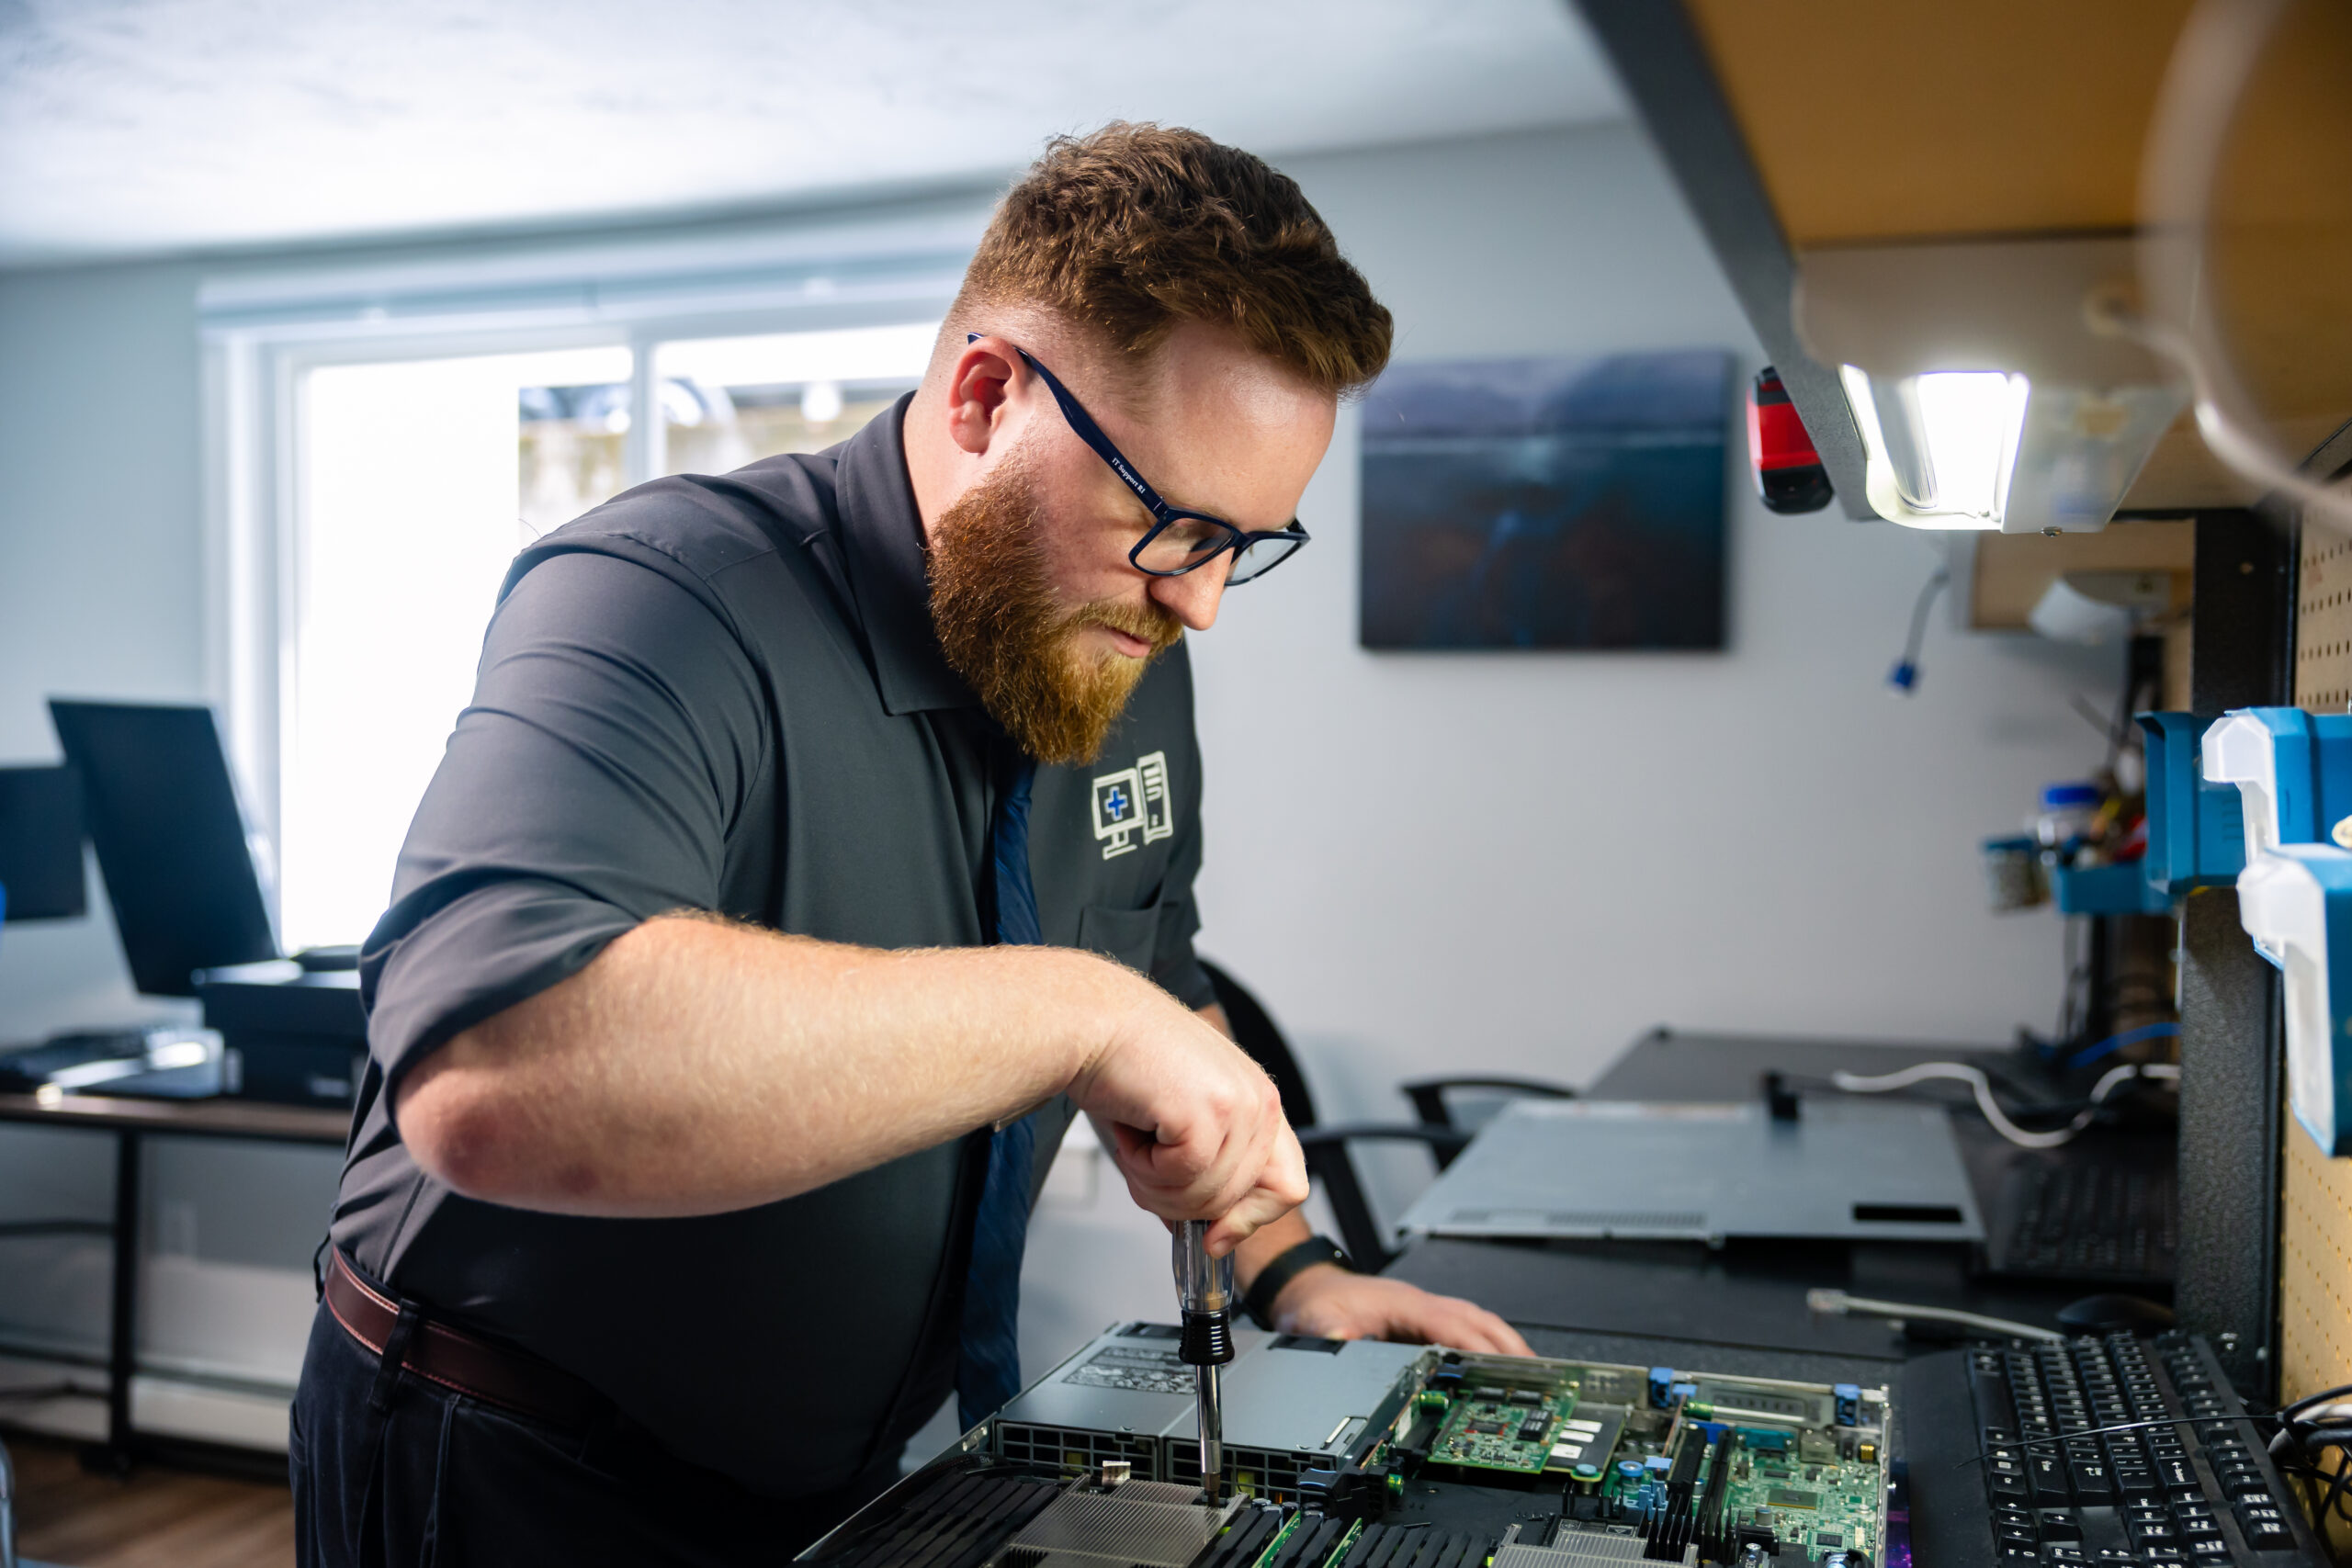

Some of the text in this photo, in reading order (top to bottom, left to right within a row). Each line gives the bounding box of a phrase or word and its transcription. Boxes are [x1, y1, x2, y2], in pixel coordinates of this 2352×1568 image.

[1112, 457, 1146, 494] IT Support RI
